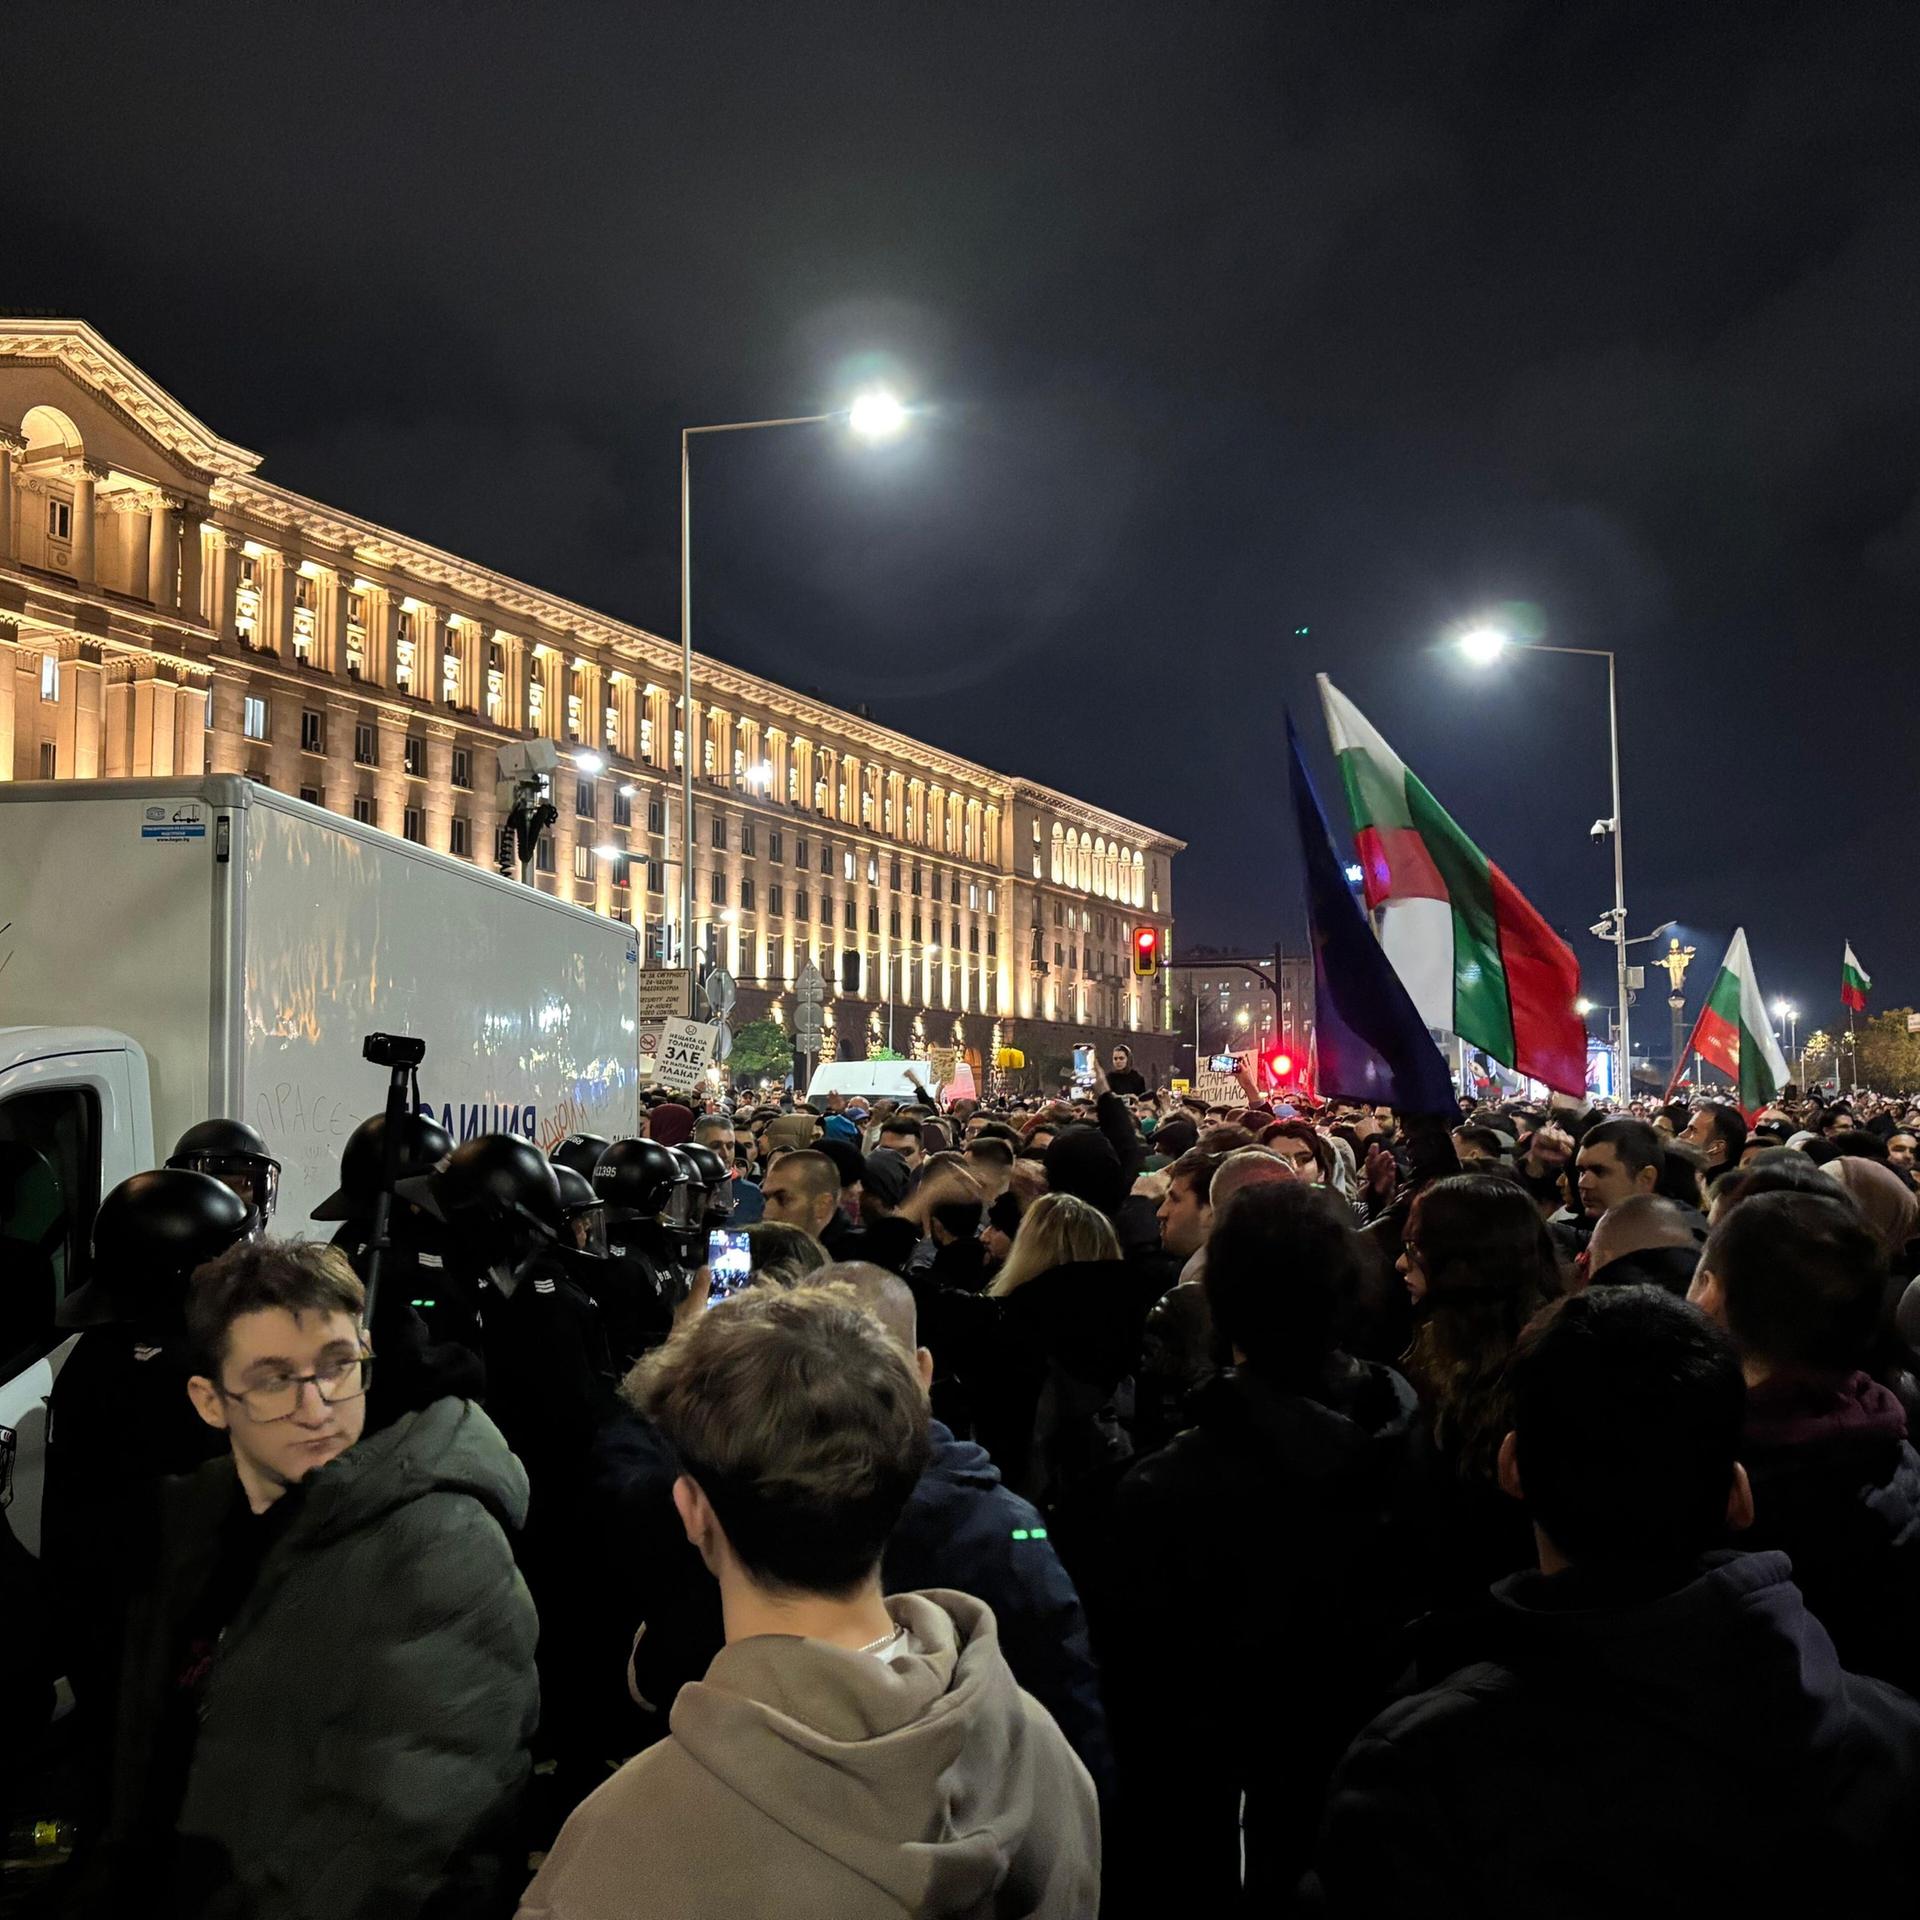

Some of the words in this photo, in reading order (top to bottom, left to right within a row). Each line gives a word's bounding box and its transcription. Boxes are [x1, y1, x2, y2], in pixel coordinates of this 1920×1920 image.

[669, 1039, 705, 1052] ТОЛКОВА
[665, 1047, 704, 1067] ЗЛЕ,
[660, 1065, 699, 1080] ПЛАКАТ
[404, 1102, 537, 1144] ЛИЦИЯ
